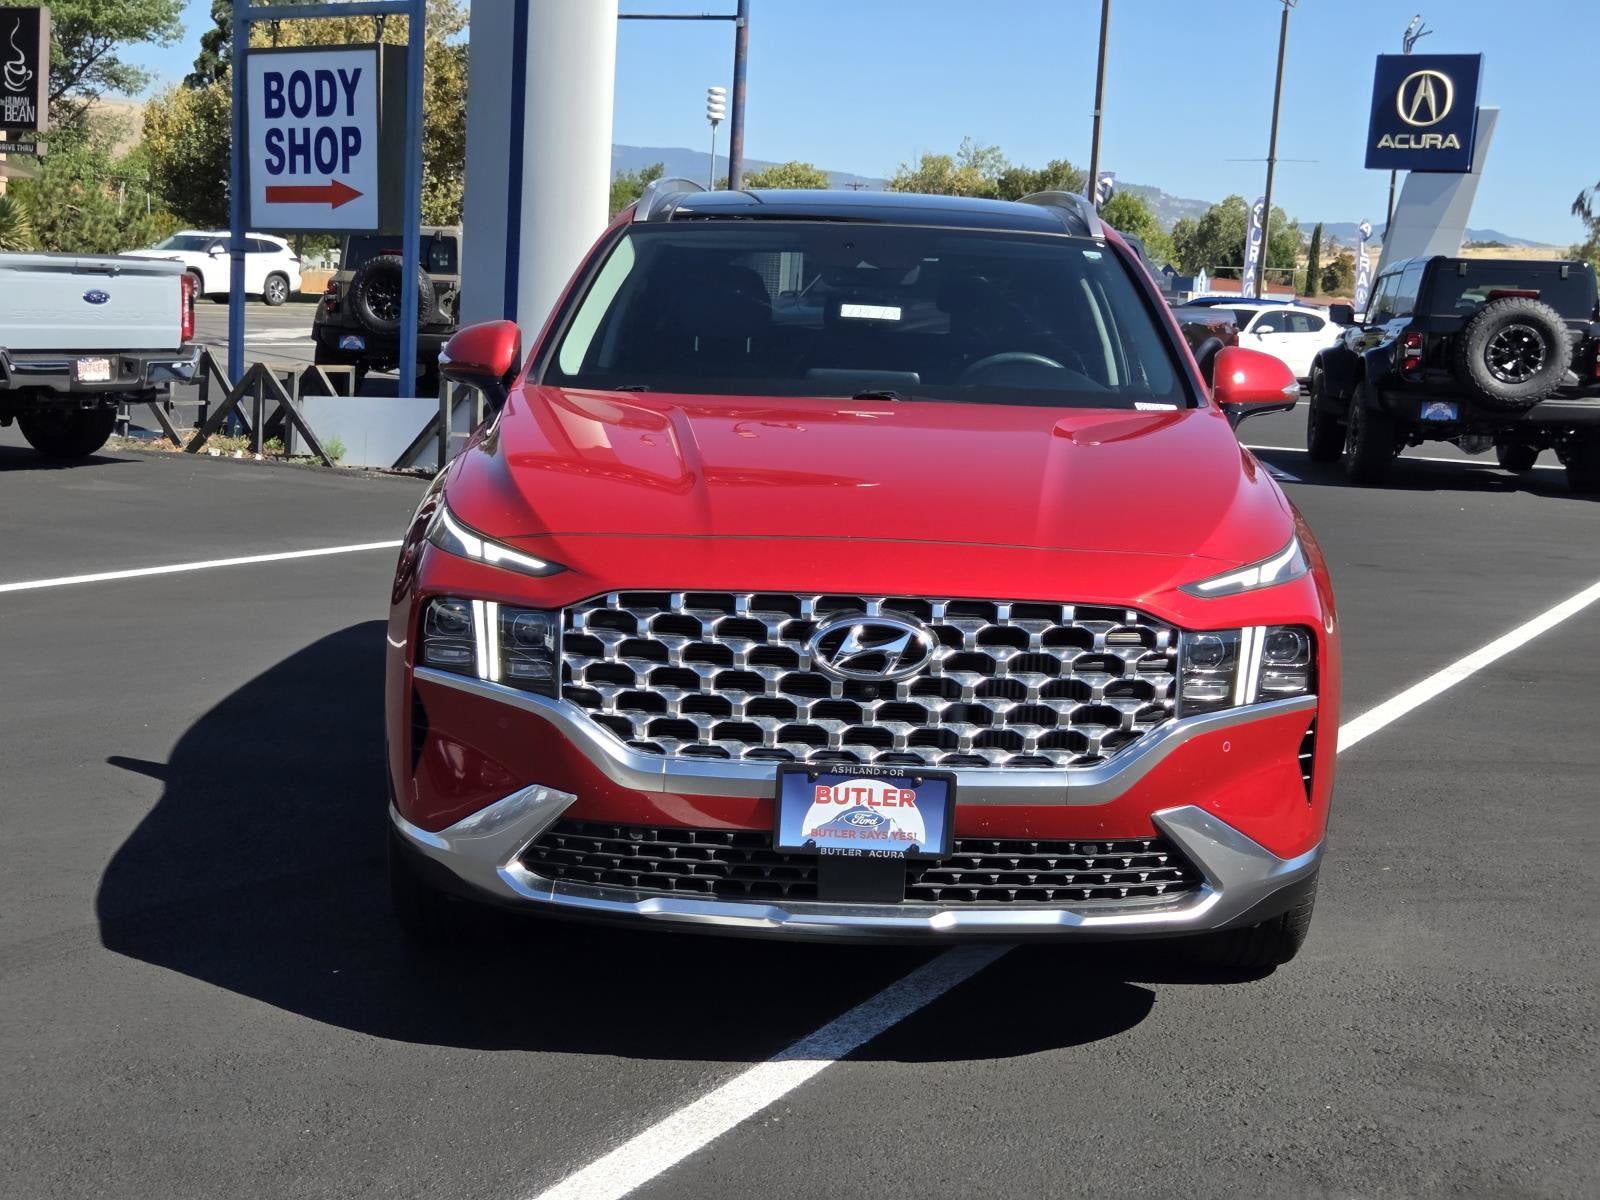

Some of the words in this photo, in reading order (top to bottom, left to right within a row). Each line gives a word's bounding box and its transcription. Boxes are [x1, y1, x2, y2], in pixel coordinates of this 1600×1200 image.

[264, 68, 362, 119] BODY
[5, 96, 30, 105] HUMAN
[5, 105, 35, 122] BEAN
[1377, 133, 1460, 149] ACURA
[17, 144, 34, 152] THRU
[265, 126, 362, 175] SHOP
[831, 766, 880, 776] ASHLAND
[889, 768, 904, 777] OR
[815, 785, 916, 808] BUTLER
[851, 813, 878, 826] Ford
[810, 828, 856, 839] BUTLER
[859, 829, 888, 840] SAYS
[891, 830, 917, 841] YES!
[820, 847, 862, 857] BUTLER
[868, 849, 905, 859] ACURA
